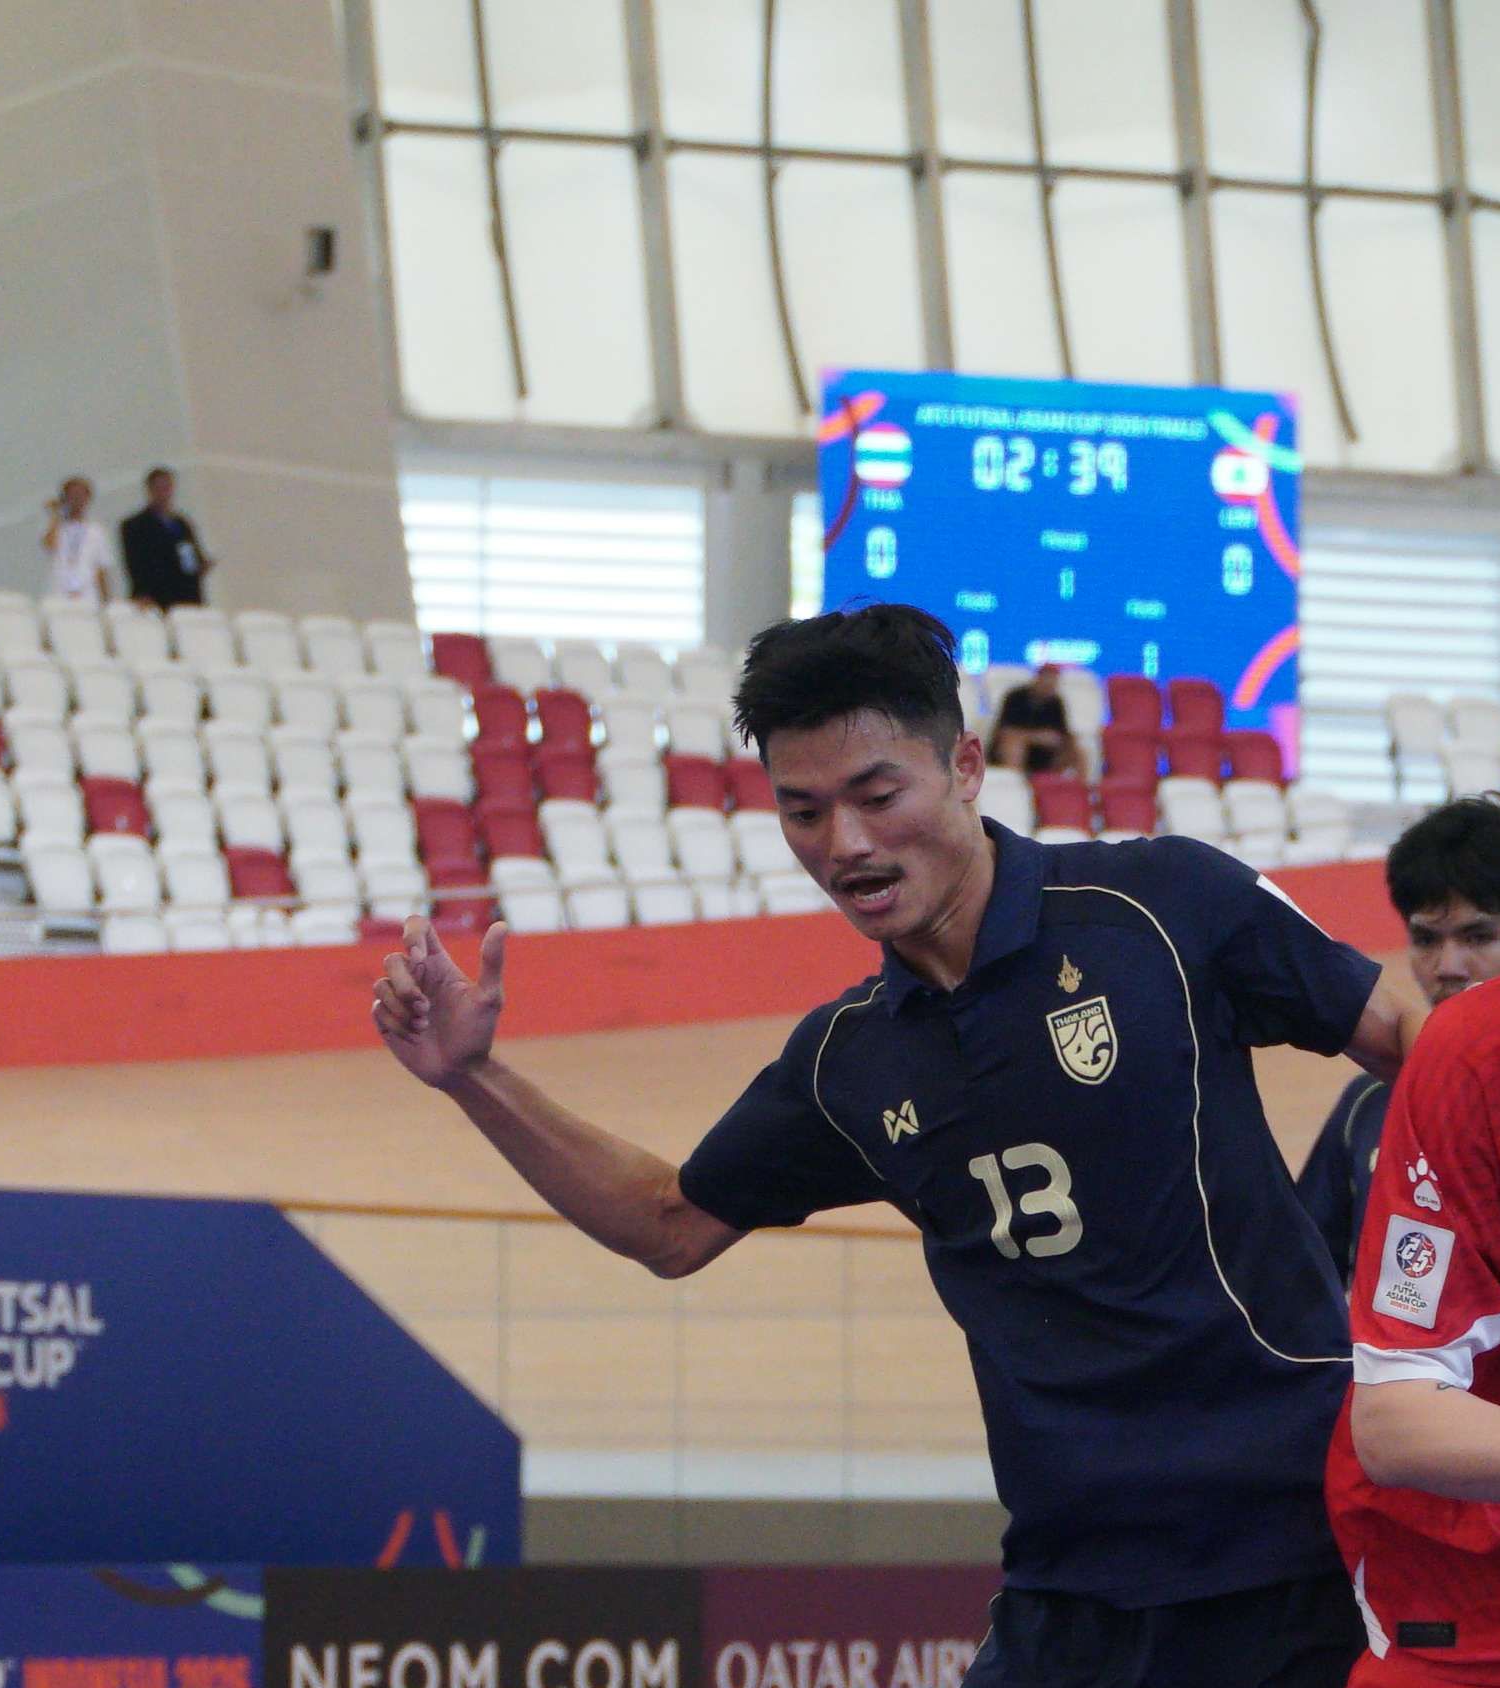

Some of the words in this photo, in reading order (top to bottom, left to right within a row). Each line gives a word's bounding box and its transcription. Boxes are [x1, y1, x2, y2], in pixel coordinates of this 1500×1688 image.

[972, 435, 1128, 496] 02:39
[865, 526, 897, 579] 0
[1222, 542, 1254, 595] 0
[969, 1143, 1083, 1258] 13
